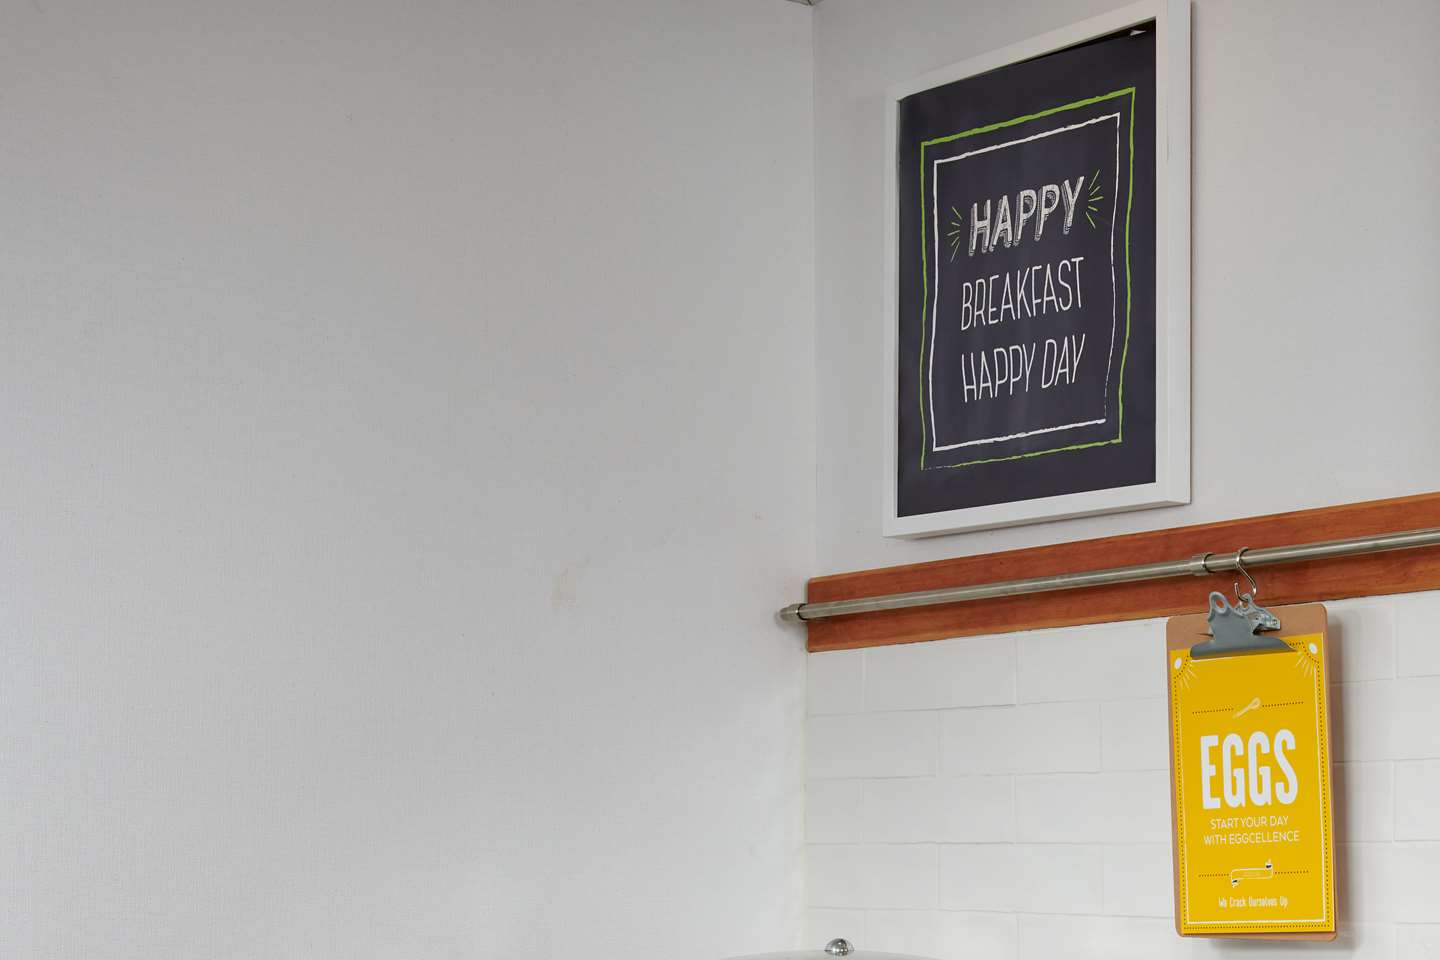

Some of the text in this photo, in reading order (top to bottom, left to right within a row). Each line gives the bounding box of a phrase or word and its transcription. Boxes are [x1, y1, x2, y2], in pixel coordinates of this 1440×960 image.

[968, 175, 1085, 257] HAPPY
[960, 257, 1085, 331] BREAKFAST
[961, 334, 1086, 402] HAPPY DAY
[1200, 729, 1298, 810] EGGS
[1203, 830, 1301, 846] WITH EGGCELLENCE
[1210, 815, 1289, 830] START YOUR DAY
